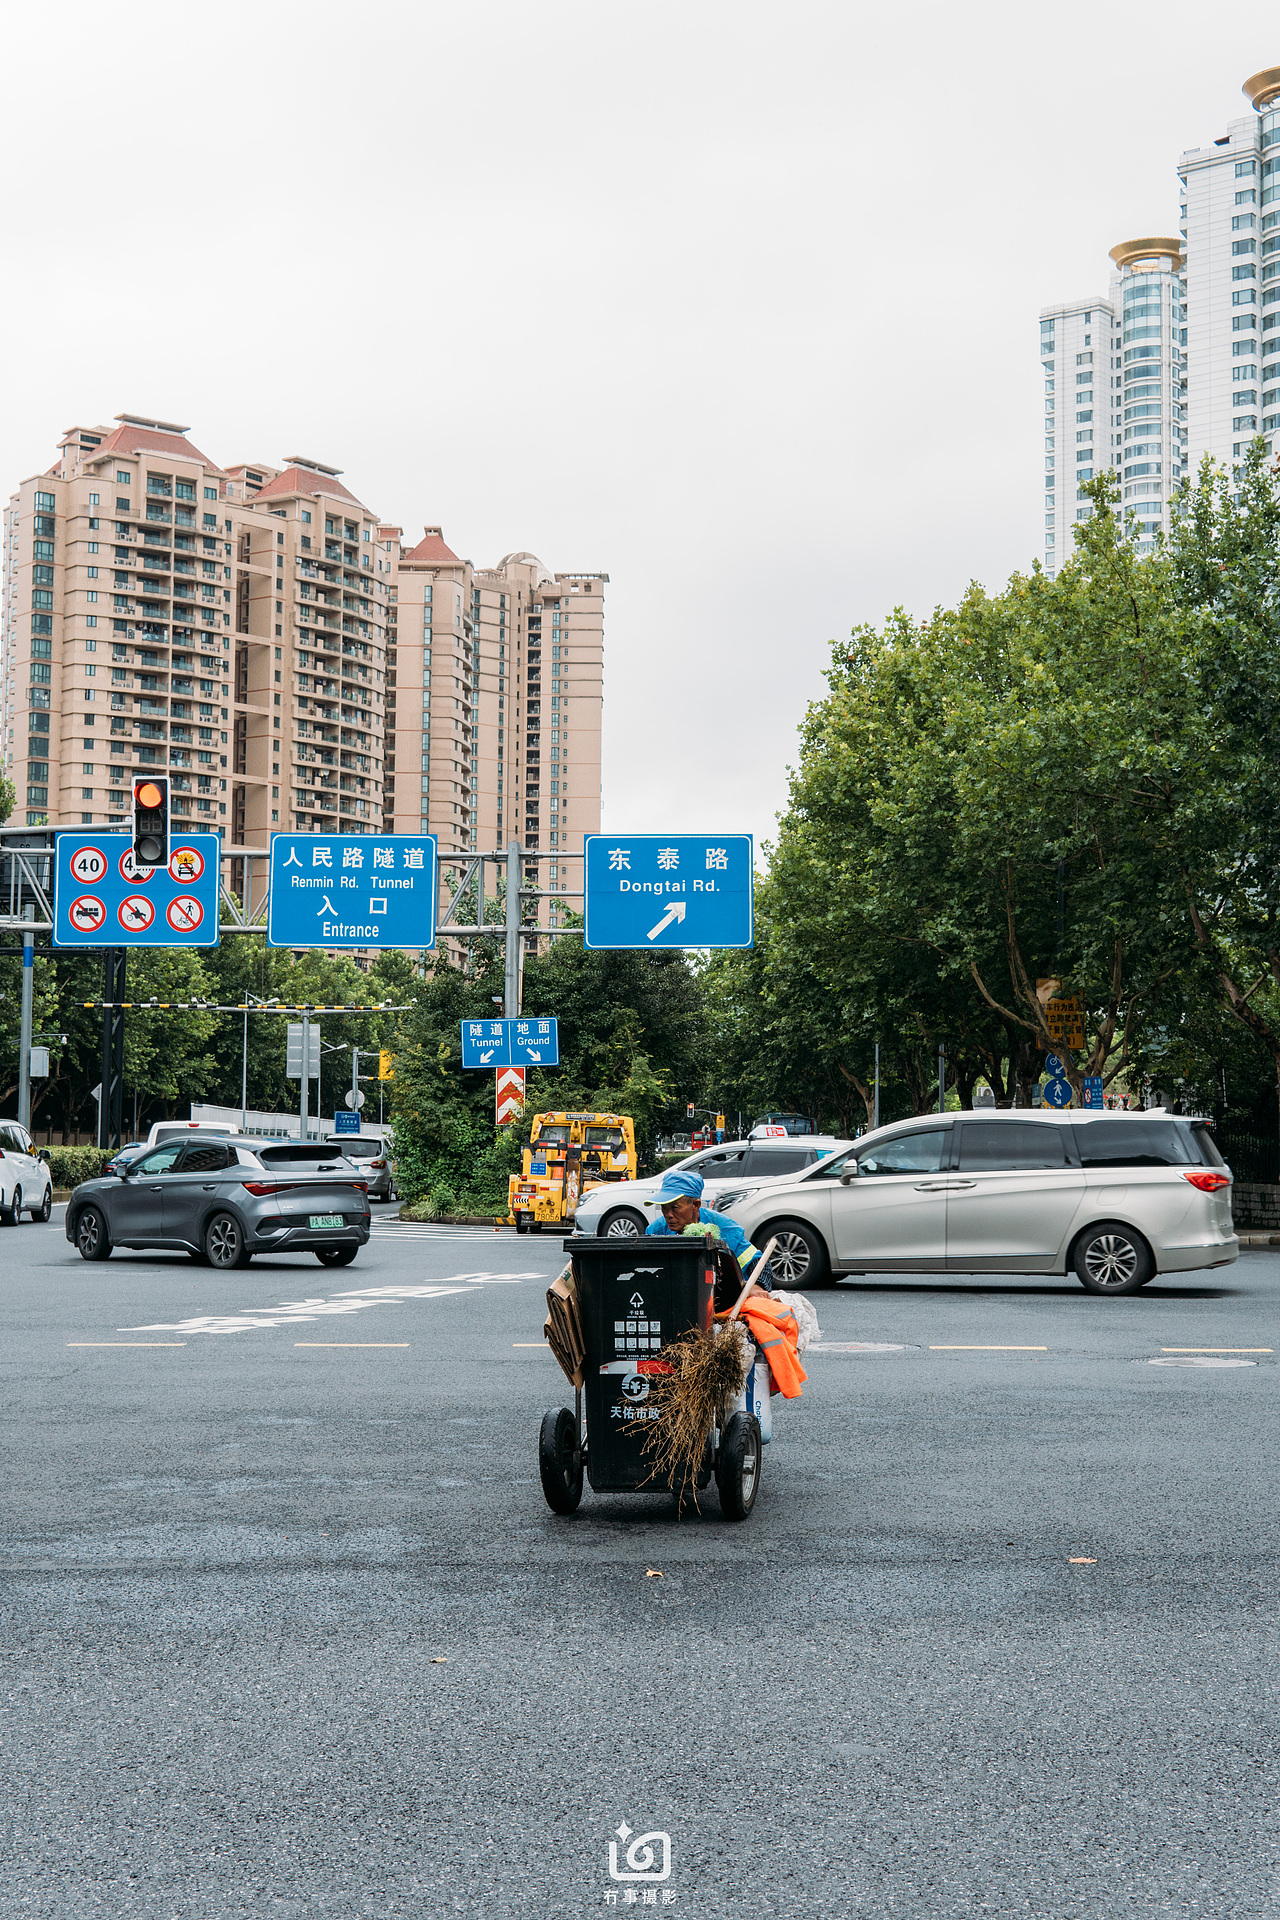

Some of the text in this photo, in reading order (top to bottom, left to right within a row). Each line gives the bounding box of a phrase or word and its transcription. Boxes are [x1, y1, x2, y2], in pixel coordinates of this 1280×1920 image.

[78, 858, 100, 872] 40
[284, 847, 425, 869] 人民路隧道
[608, 848, 729, 870] 东泰路
[291, 876, 414, 889] Renmin Rd. Tunnel
[619, 880, 720, 895] Dongtai Rd.
[316, 895, 388, 916] 入口
[323, 921, 380, 938] Entrance
[469, 1022, 503, 1036] 隧道
[517, 1021, 550, 1034] 地面
[470, 1037, 503, 1047] Tunnel
[517, 1036, 550, 1046] Ground
[610, 1406, 661, 1420] 天佑市政
